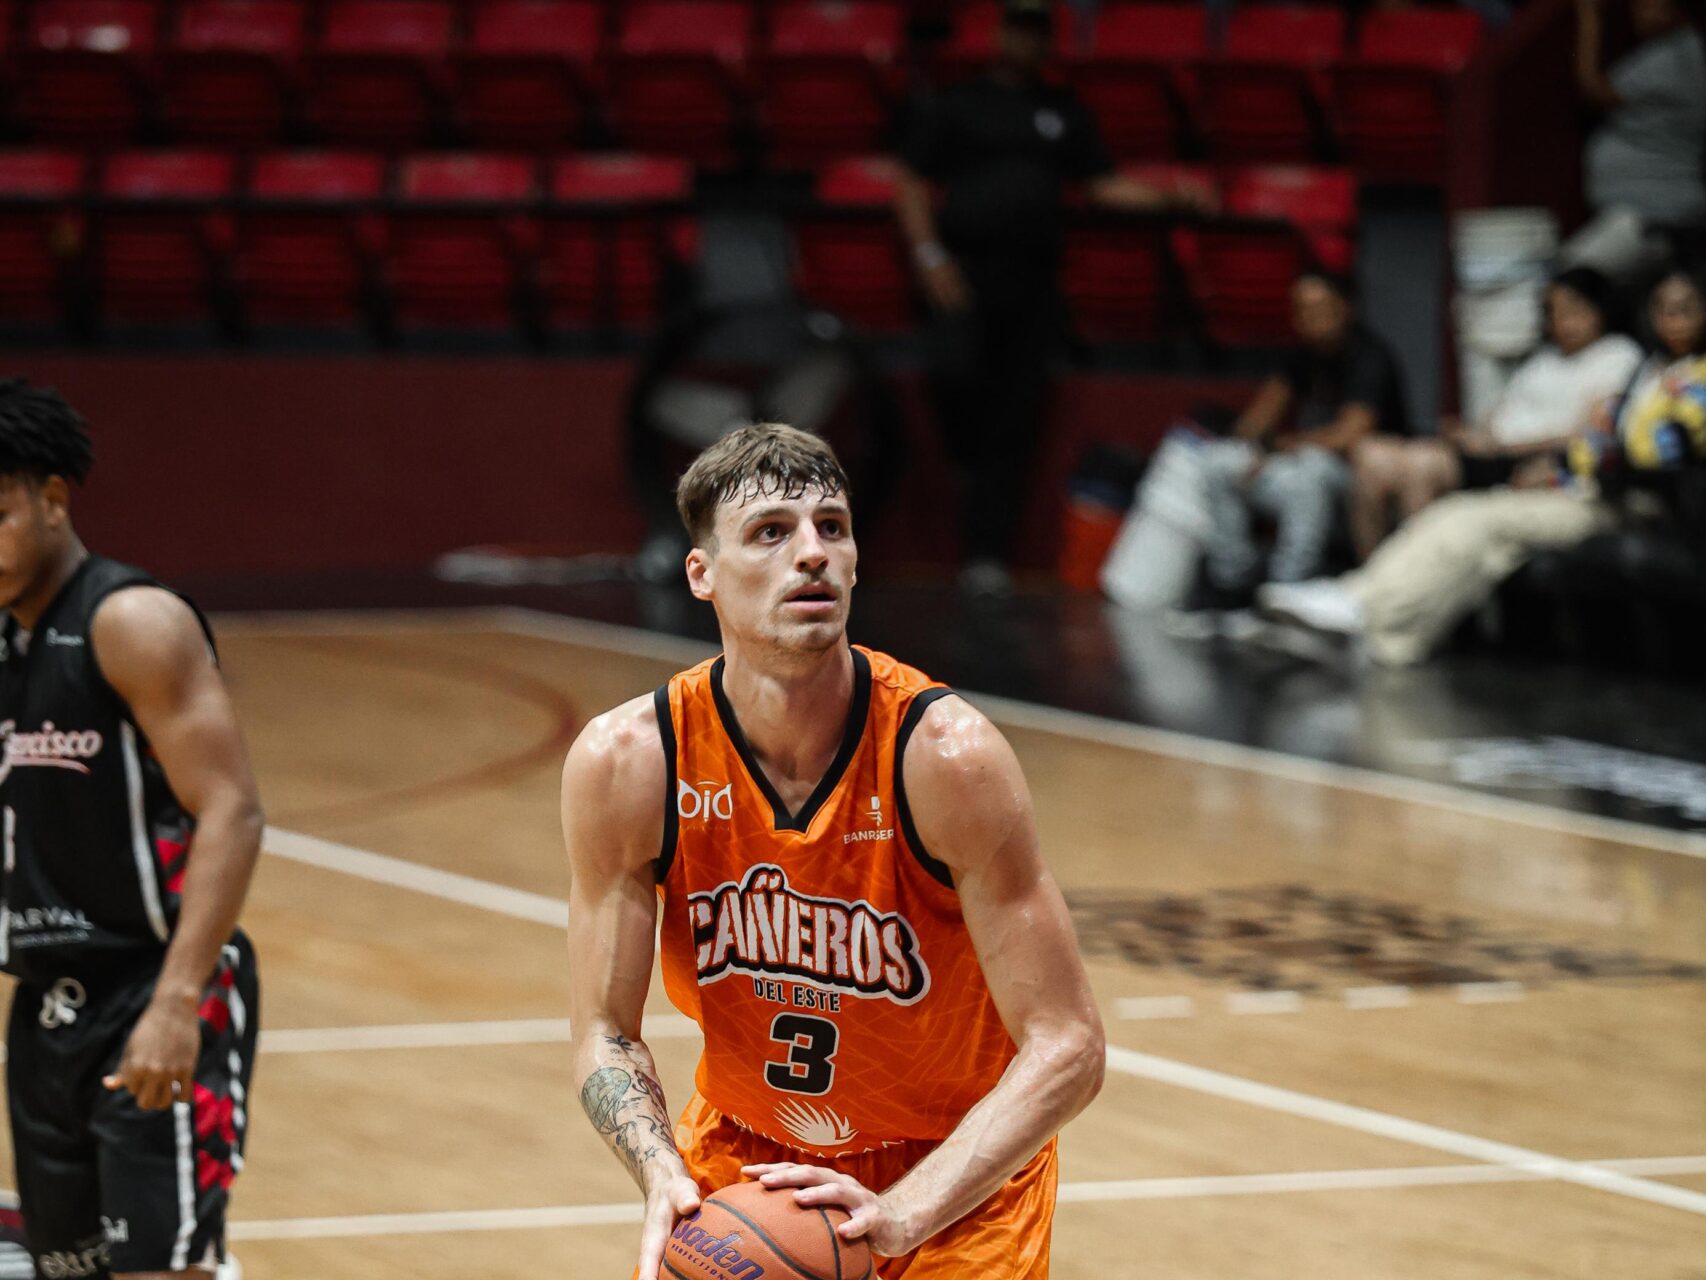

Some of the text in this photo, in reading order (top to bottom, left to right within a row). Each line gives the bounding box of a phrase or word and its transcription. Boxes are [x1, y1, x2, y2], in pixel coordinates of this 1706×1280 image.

[688, 868, 925, 1000] CAÑEROS
[753, 977, 841, 1013] DEL ESTE
[763, 1012, 841, 1096] 3
